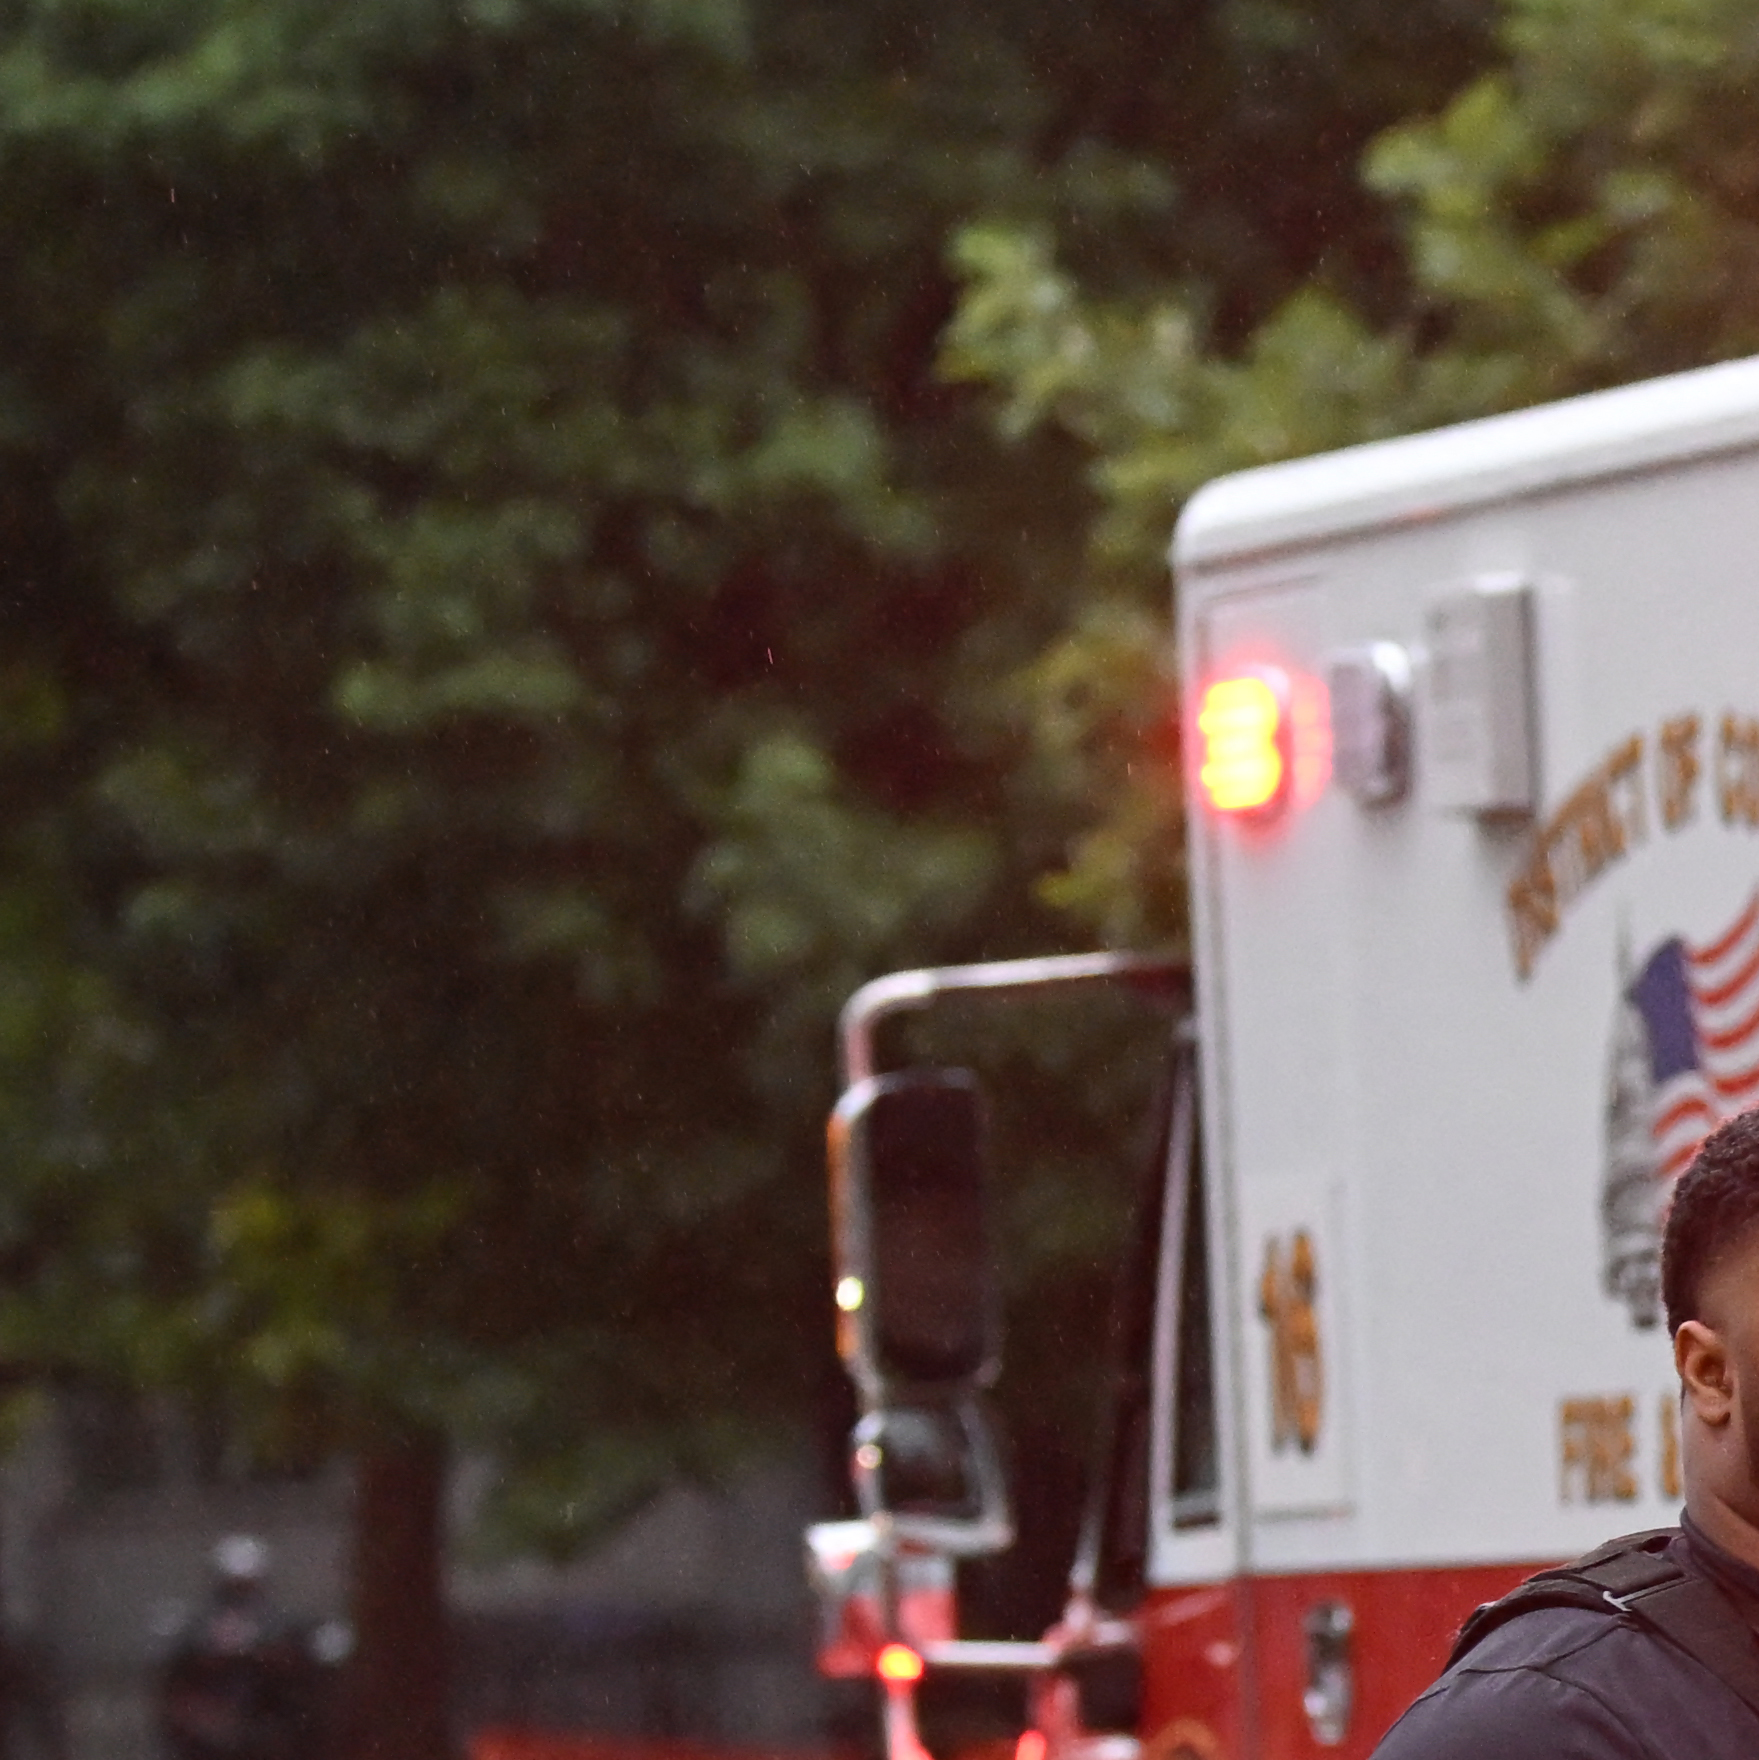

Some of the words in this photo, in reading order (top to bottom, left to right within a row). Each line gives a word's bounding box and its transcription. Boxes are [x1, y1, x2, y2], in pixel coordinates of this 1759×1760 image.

[1656, 711, 1701, 836] OF
[1259, 1223, 1324, 1461] 16
[1557, 1392, 1638, 1506] FIRE
